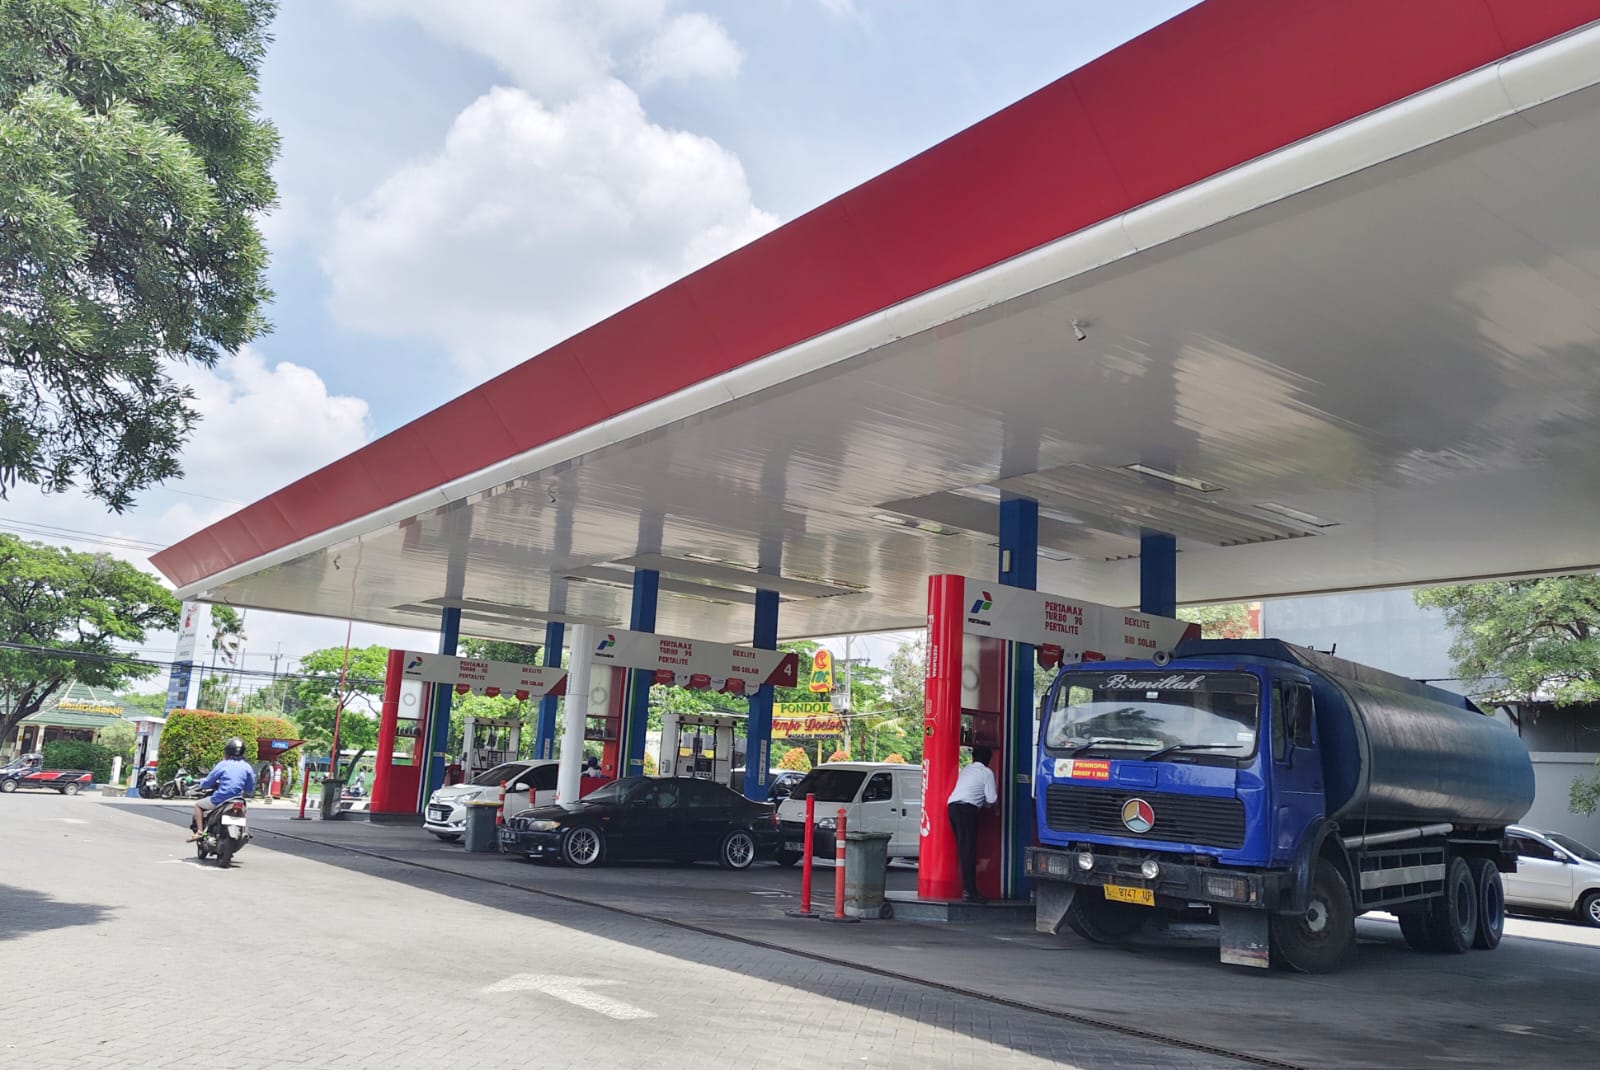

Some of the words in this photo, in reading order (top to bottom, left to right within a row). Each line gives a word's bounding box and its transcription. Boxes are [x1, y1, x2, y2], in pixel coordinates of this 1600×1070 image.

[1045, 601, 1083, 616] PERTAMAX
[1045, 611, 1067, 622] TURBO
[1045, 621, 1079, 635] PERTALITE
[1124, 616, 1150, 629] DEXLITE
[660, 640, 692, 649] PERTAMAX
[1124, 635, 1135, 645] BIO
[1138, 638, 1157, 649] SOLAR
[733, 650, 755, 659] DEXLITE
[659, 656, 688, 665] PERTALITE
[784, 664, 792, 676] 4
[1099, 674, 1205, 689] Bismillah
[780, 703, 829, 713] PONDOK
[1119, 888, 1137, 898] 8747
